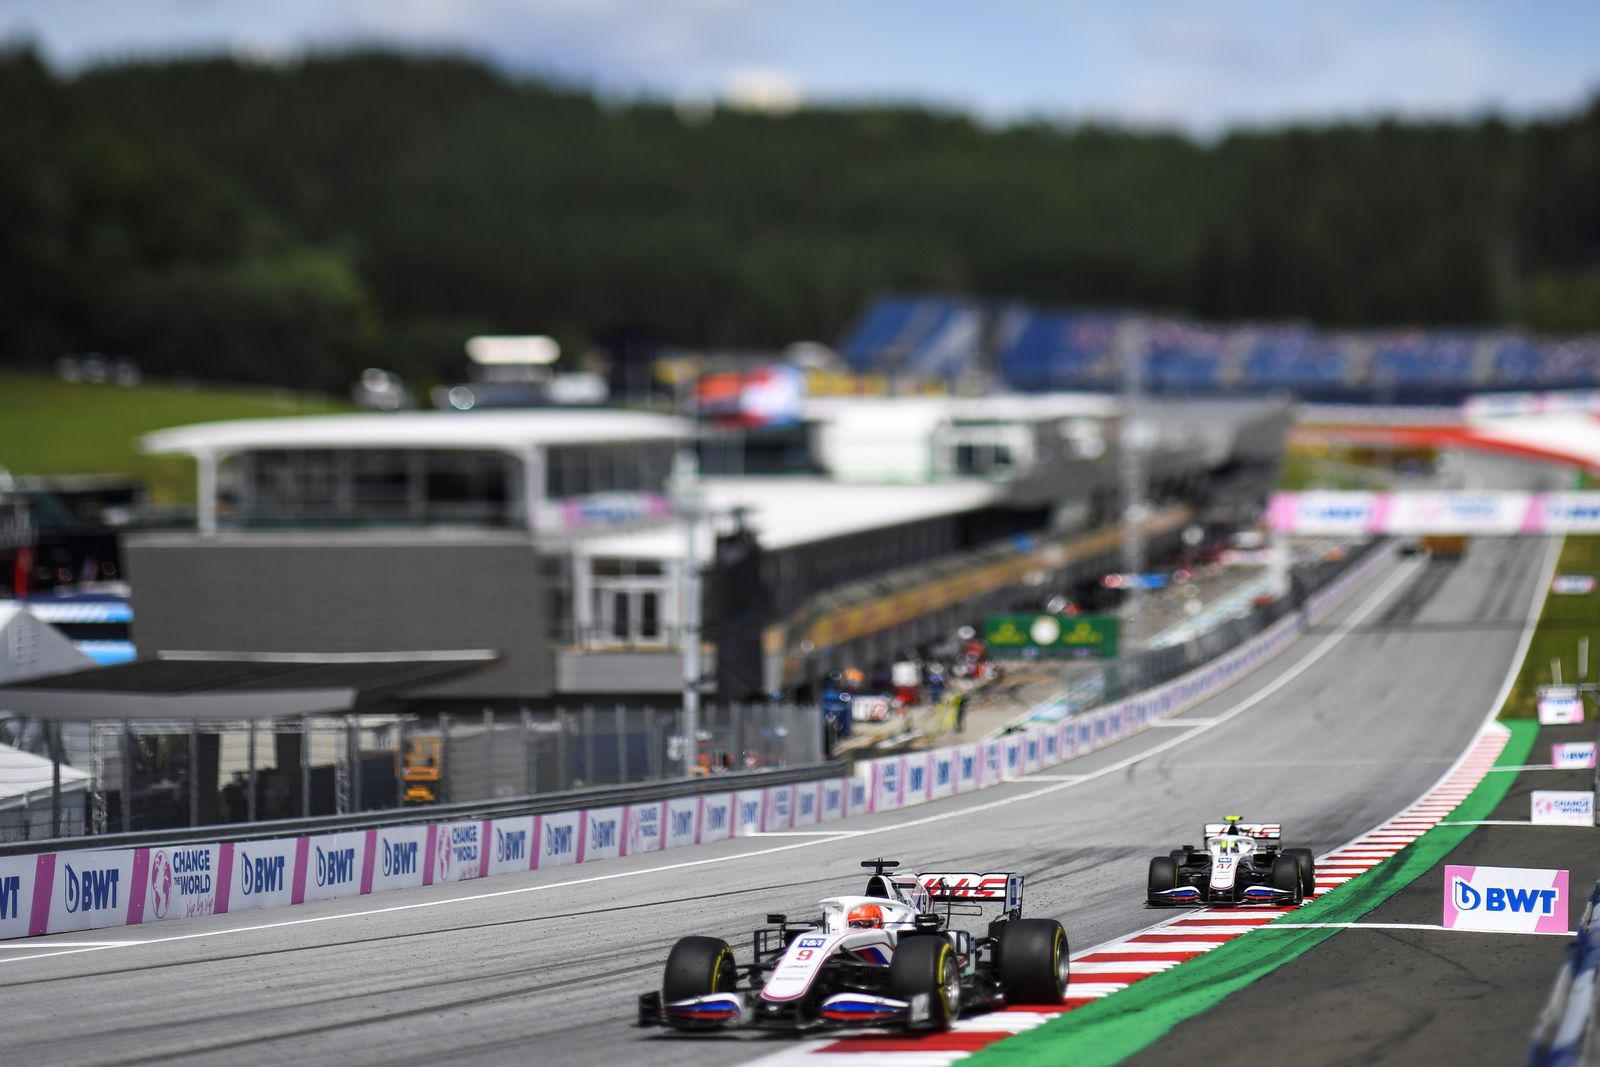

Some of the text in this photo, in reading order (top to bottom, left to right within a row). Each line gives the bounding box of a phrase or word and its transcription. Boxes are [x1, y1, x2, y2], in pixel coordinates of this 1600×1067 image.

[452, 826, 477, 844] CHANGE
[505, 830, 525, 861] BWT
[554, 825, 572, 855] BWT
[173, 850, 210, 873] CHANGE
[327, 848, 354, 885] BWT
[393, 842, 417, 876] BWT
[181, 874, 211, 895] WORLD
[255, 856, 285, 893] BWT
[82, 869, 119, 912] BWT
[1486, 888, 1556, 913] BWT
[796, 949, 814, 960] 9
[802, 939, 823, 947] 1&1
